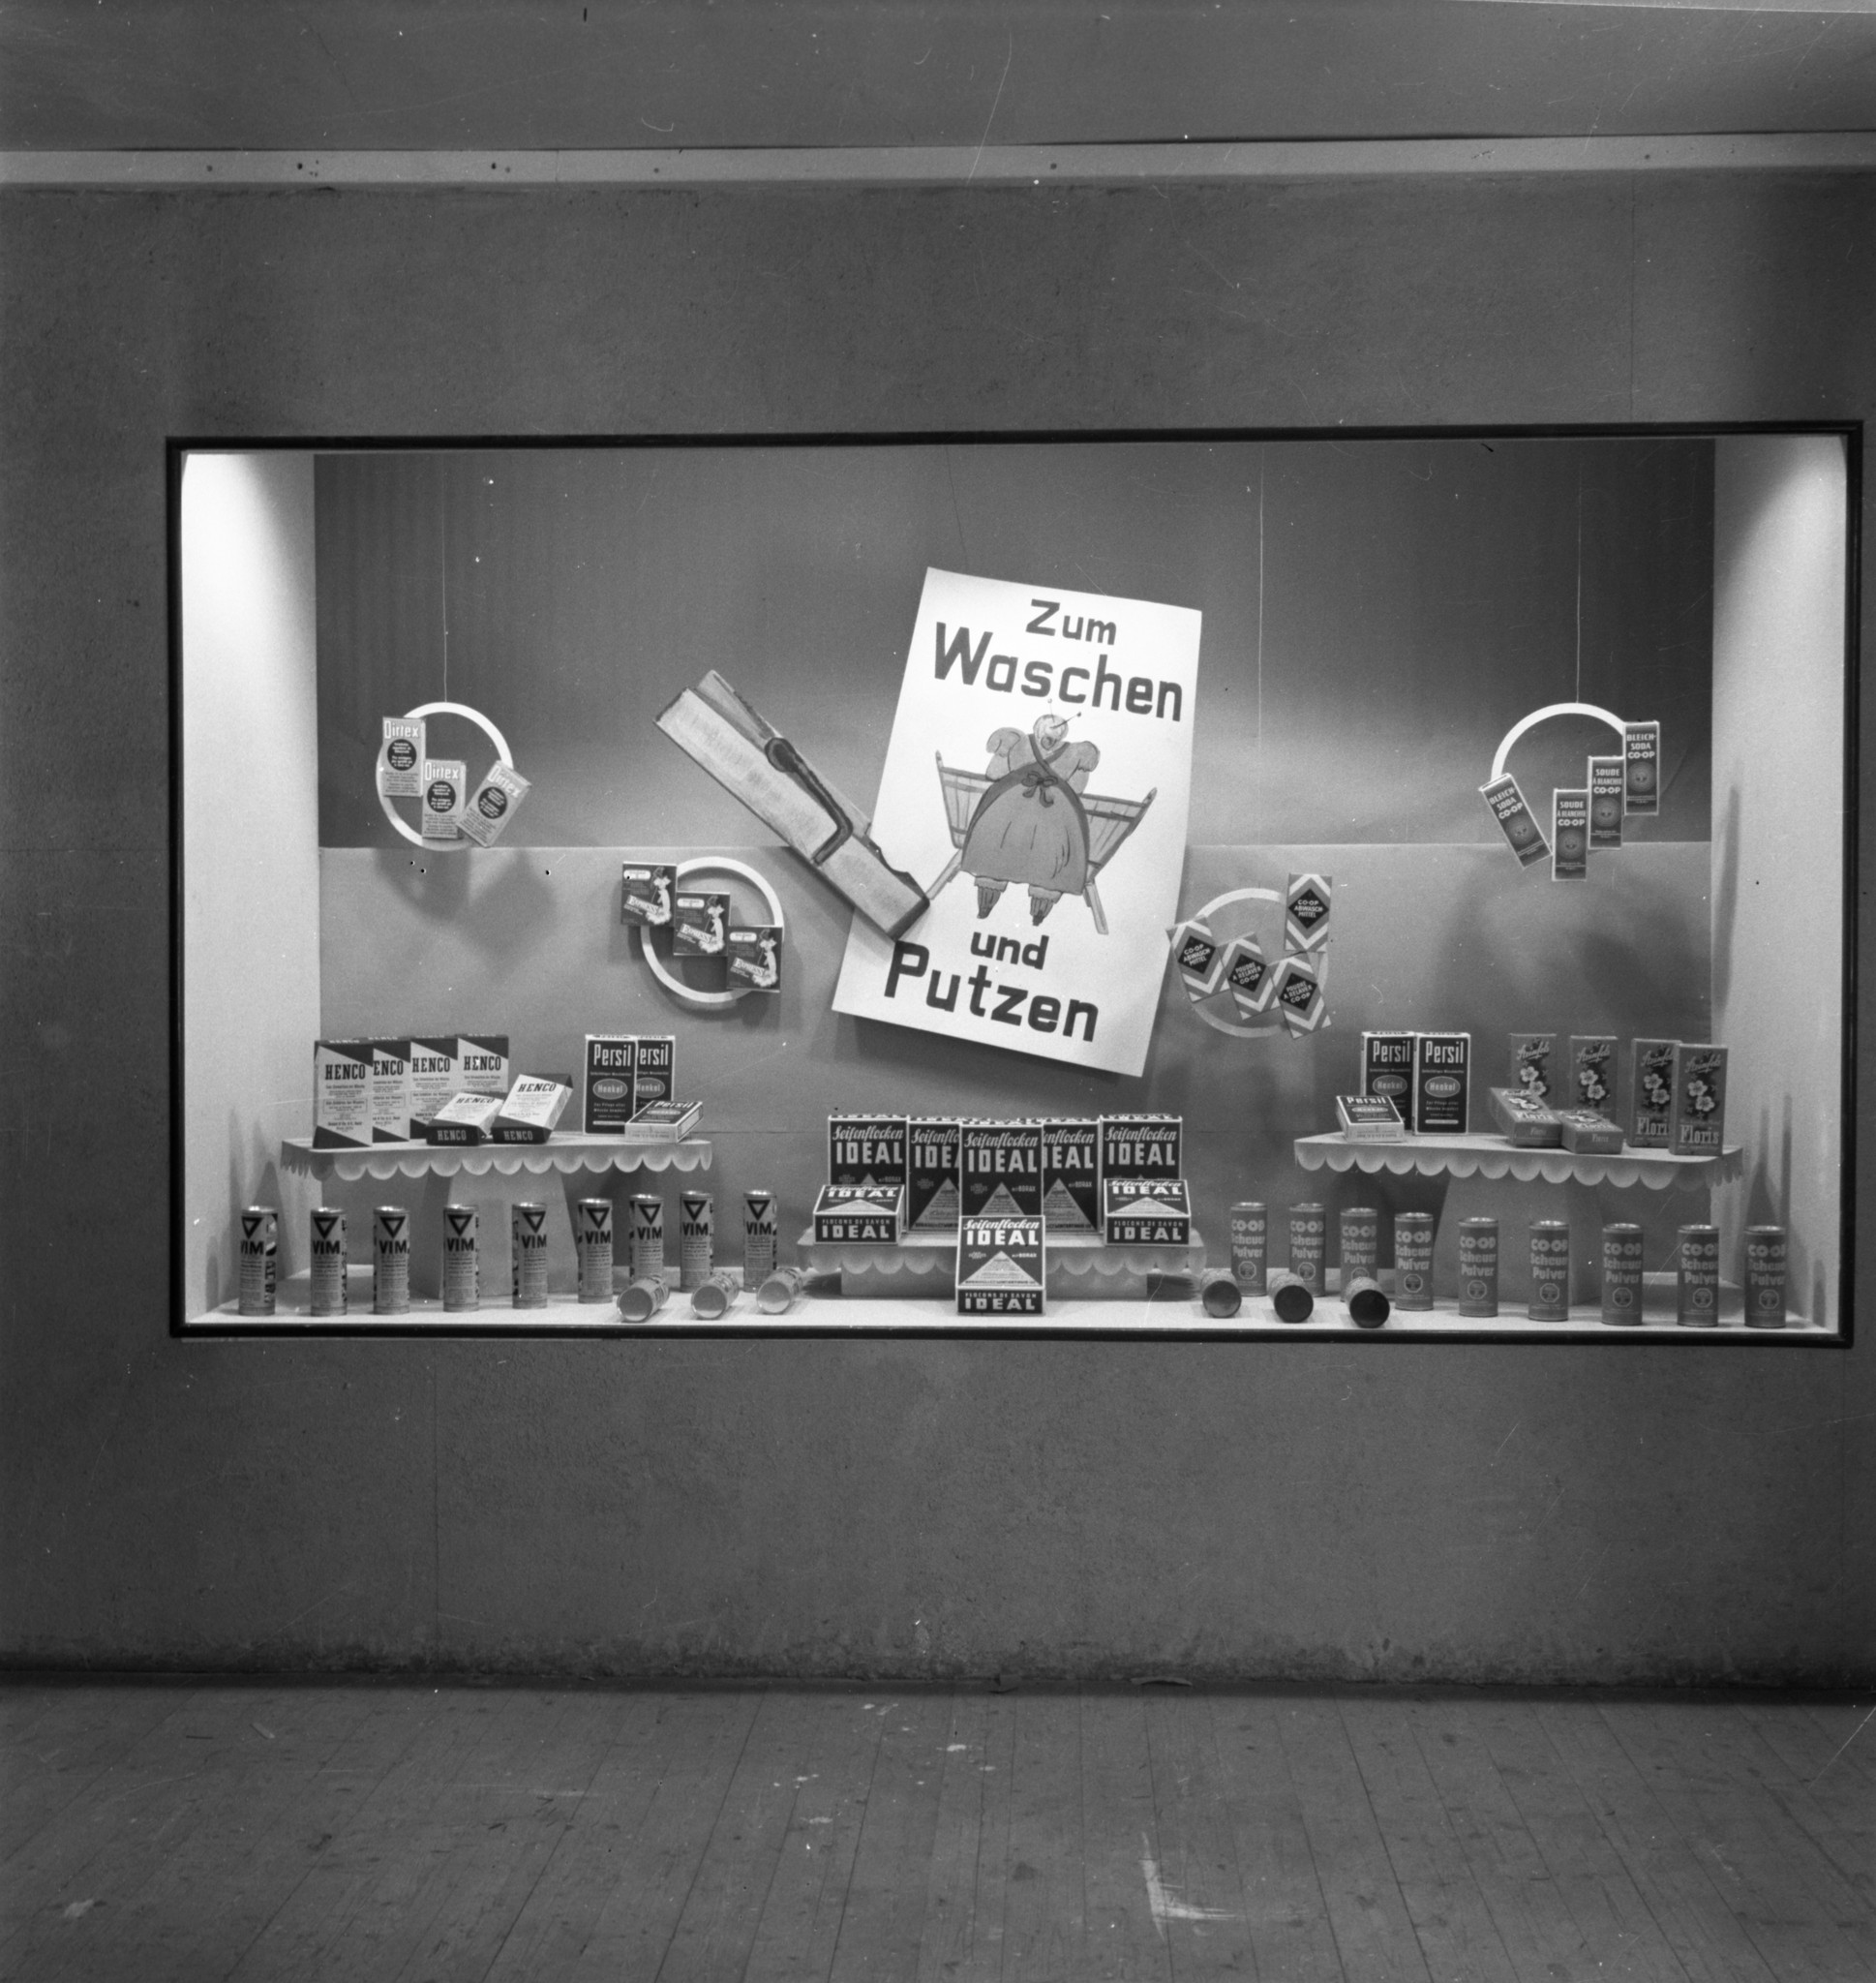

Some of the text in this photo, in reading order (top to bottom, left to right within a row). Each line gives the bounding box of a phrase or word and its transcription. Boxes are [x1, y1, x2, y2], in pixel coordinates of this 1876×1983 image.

[1025, 598, 1118, 646] Zum
[934, 622, 1183, 722] Waschen
[384, 719, 420, 739] Dirtex
[424, 762, 460, 781] Dirtex
[1595, 768, 1620, 777] SOUDE
[487, 765, 523, 799] Dirtex
[1497, 798, 1517, 810] SODA
[1559, 801, 1584, 809] SOUDE
[970, 930, 1049, 970] und
[1183, 948, 1210, 962] ABWASCH
[1189, 956, 1207, 966] MITTEL
[1235, 961, 1256, 973] POUDRE
[1237, 965, 1262, 979] RELAVER
[884, 939, 1100, 1043] Putzen
[1286, 980, 1307, 992] POUDRE
[1288, 985, 1313, 998] RELAVER
[593, 1044, 632, 1067] Persil
[637, 1044, 670, 1066] ersil
[1373, 1040, 1410, 1063] Persil
[1425, 1040, 1464, 1064] Persil
[373, 1059, 405, 1076] ENCO
[411, 1057, 451, 1073] HENCO
[464, 1055, 501, 1072] HENCO
[324, 1063, 366, 1081] HENCO
[517, 1083, 558, 1093] HENCO
[596, 1083, 623, 1094] Henkel
[1377, 1080, 1403, 1090] Henkel
[1429, 1082, 1456, 1092] Henkel
[455, 1096, 496, 1105] HENCO
[1346, 1096, 1387, 1105] Persil
[832, 1125, 904, 1142] Seifenflocken
[1637, 1116, 1668, 1136] Flori
[438, 1129, 467, 1142] HENCO
[503, 1130, 533, 1142] HENCO
[911, 1128, 959, 1144] Seifenflo
[963, 1132, 1039, 1149] Seifenflocken
[1044, 1129, 1095, 1145] enflocken
[1104, 1126, 1178, 1143] Seifenflocken
[1680, 1124, 1720, 1144] Floris
[836, 1142, 903, 1164] IDEAL
[915, 1145, 959, 1169] IDE
[1044, 1145, 1094, 1170] EAL
[1108, 1143, 1175, 1166] IDEAL
[968, 1149, 1038, 1174] IDEAL
[1112, 1186, 1182, 1195] IDEAL
[682, 1222, 709, 1236] VIM
[745, 1221, 772, 1236] VIM
[822, 1225, 890, 1238] IDEAL
[963, 1219, 1041, 1231] Seifenflocken
[585, 1230, 611, 1245] VIM
[637, 1227, 662, 1240] VIM
[967, 1230, 1039, 1245] IDEAL
[1114, 1227, 1182, 1240] IDEAL
[313, 1240, 341, 1255] VIM
[379, 1240, 407, 1255] VIM
[446, 1237, 474, 1252] VIM
[521, 1234, 547, 1249] VIM
[1232, 1245, 1263, 1259] Pulver
[1291, 1246, 1322, 1260] Pulver
[1344, 1252, 1376, 1265] Pulver
[1395, 1245, 1432, 1258] Scheuer
[1460, 1251, 1497, 1263] Scheuer
[1397, 1258, 1430, 1271] Pulver
[1462, 1264, 1495, 1277] Pulver
[1532, 1266, 1566, 1280] Pulver
[1606, 1270, 1641, 1284] Pulver
[965, 1297, 1035, 1310] IDEAL
